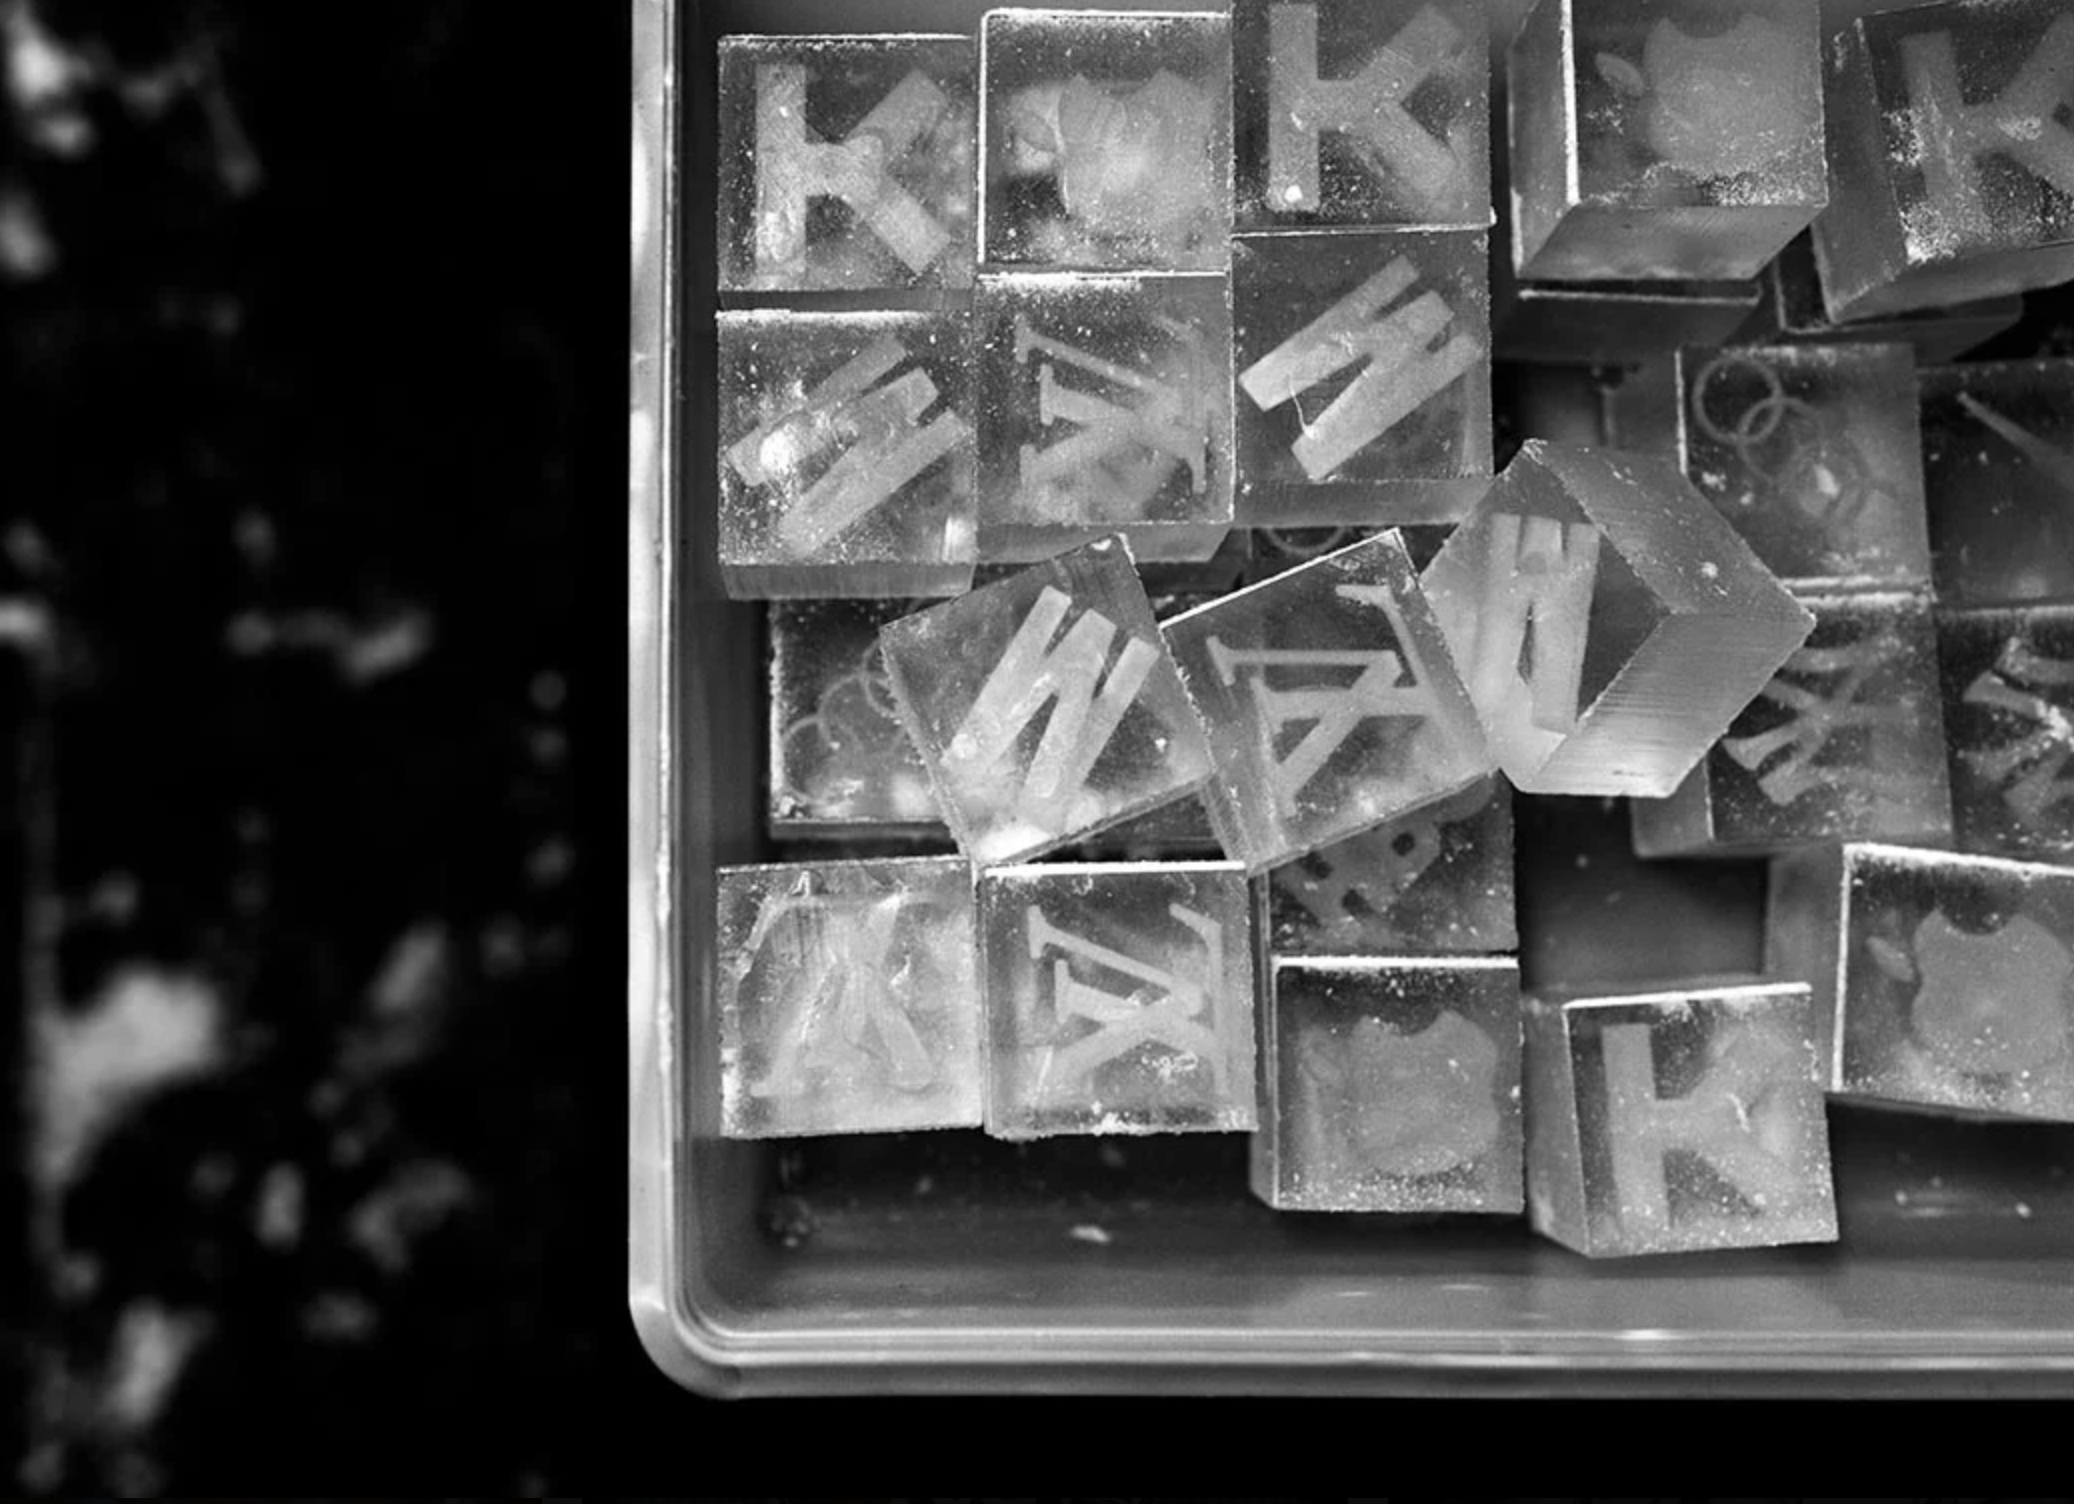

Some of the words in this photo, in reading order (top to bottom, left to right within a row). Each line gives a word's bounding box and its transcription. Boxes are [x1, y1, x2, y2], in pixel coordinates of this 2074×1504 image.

[756, 63, 950, 275] K
[1267, 0, 1456, 212] K
[1602, 1022, 1800, 1230] K
